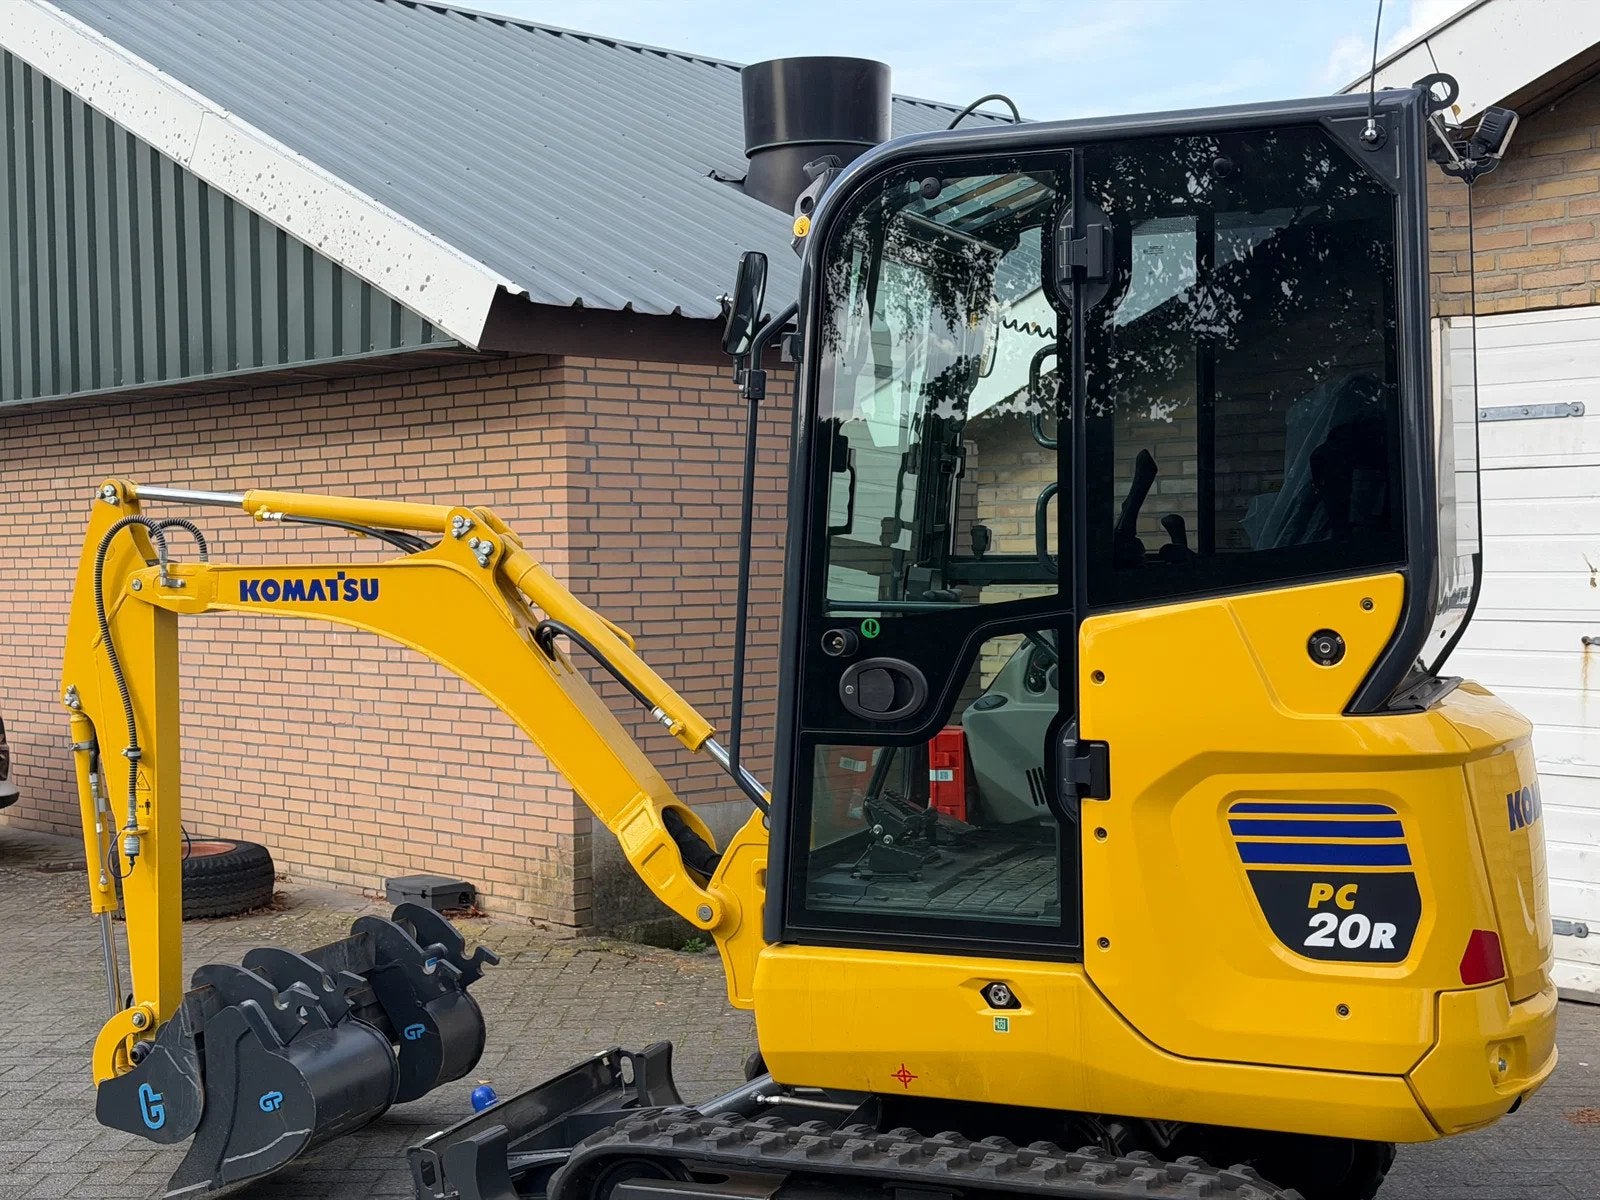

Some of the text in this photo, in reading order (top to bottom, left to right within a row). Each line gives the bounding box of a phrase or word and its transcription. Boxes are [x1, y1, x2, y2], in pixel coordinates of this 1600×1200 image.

[240, 571, 379, 602] KOMATSU
[1308, 883, 1358, 910] PC
[1303, 912, 1397, 949] 20R
